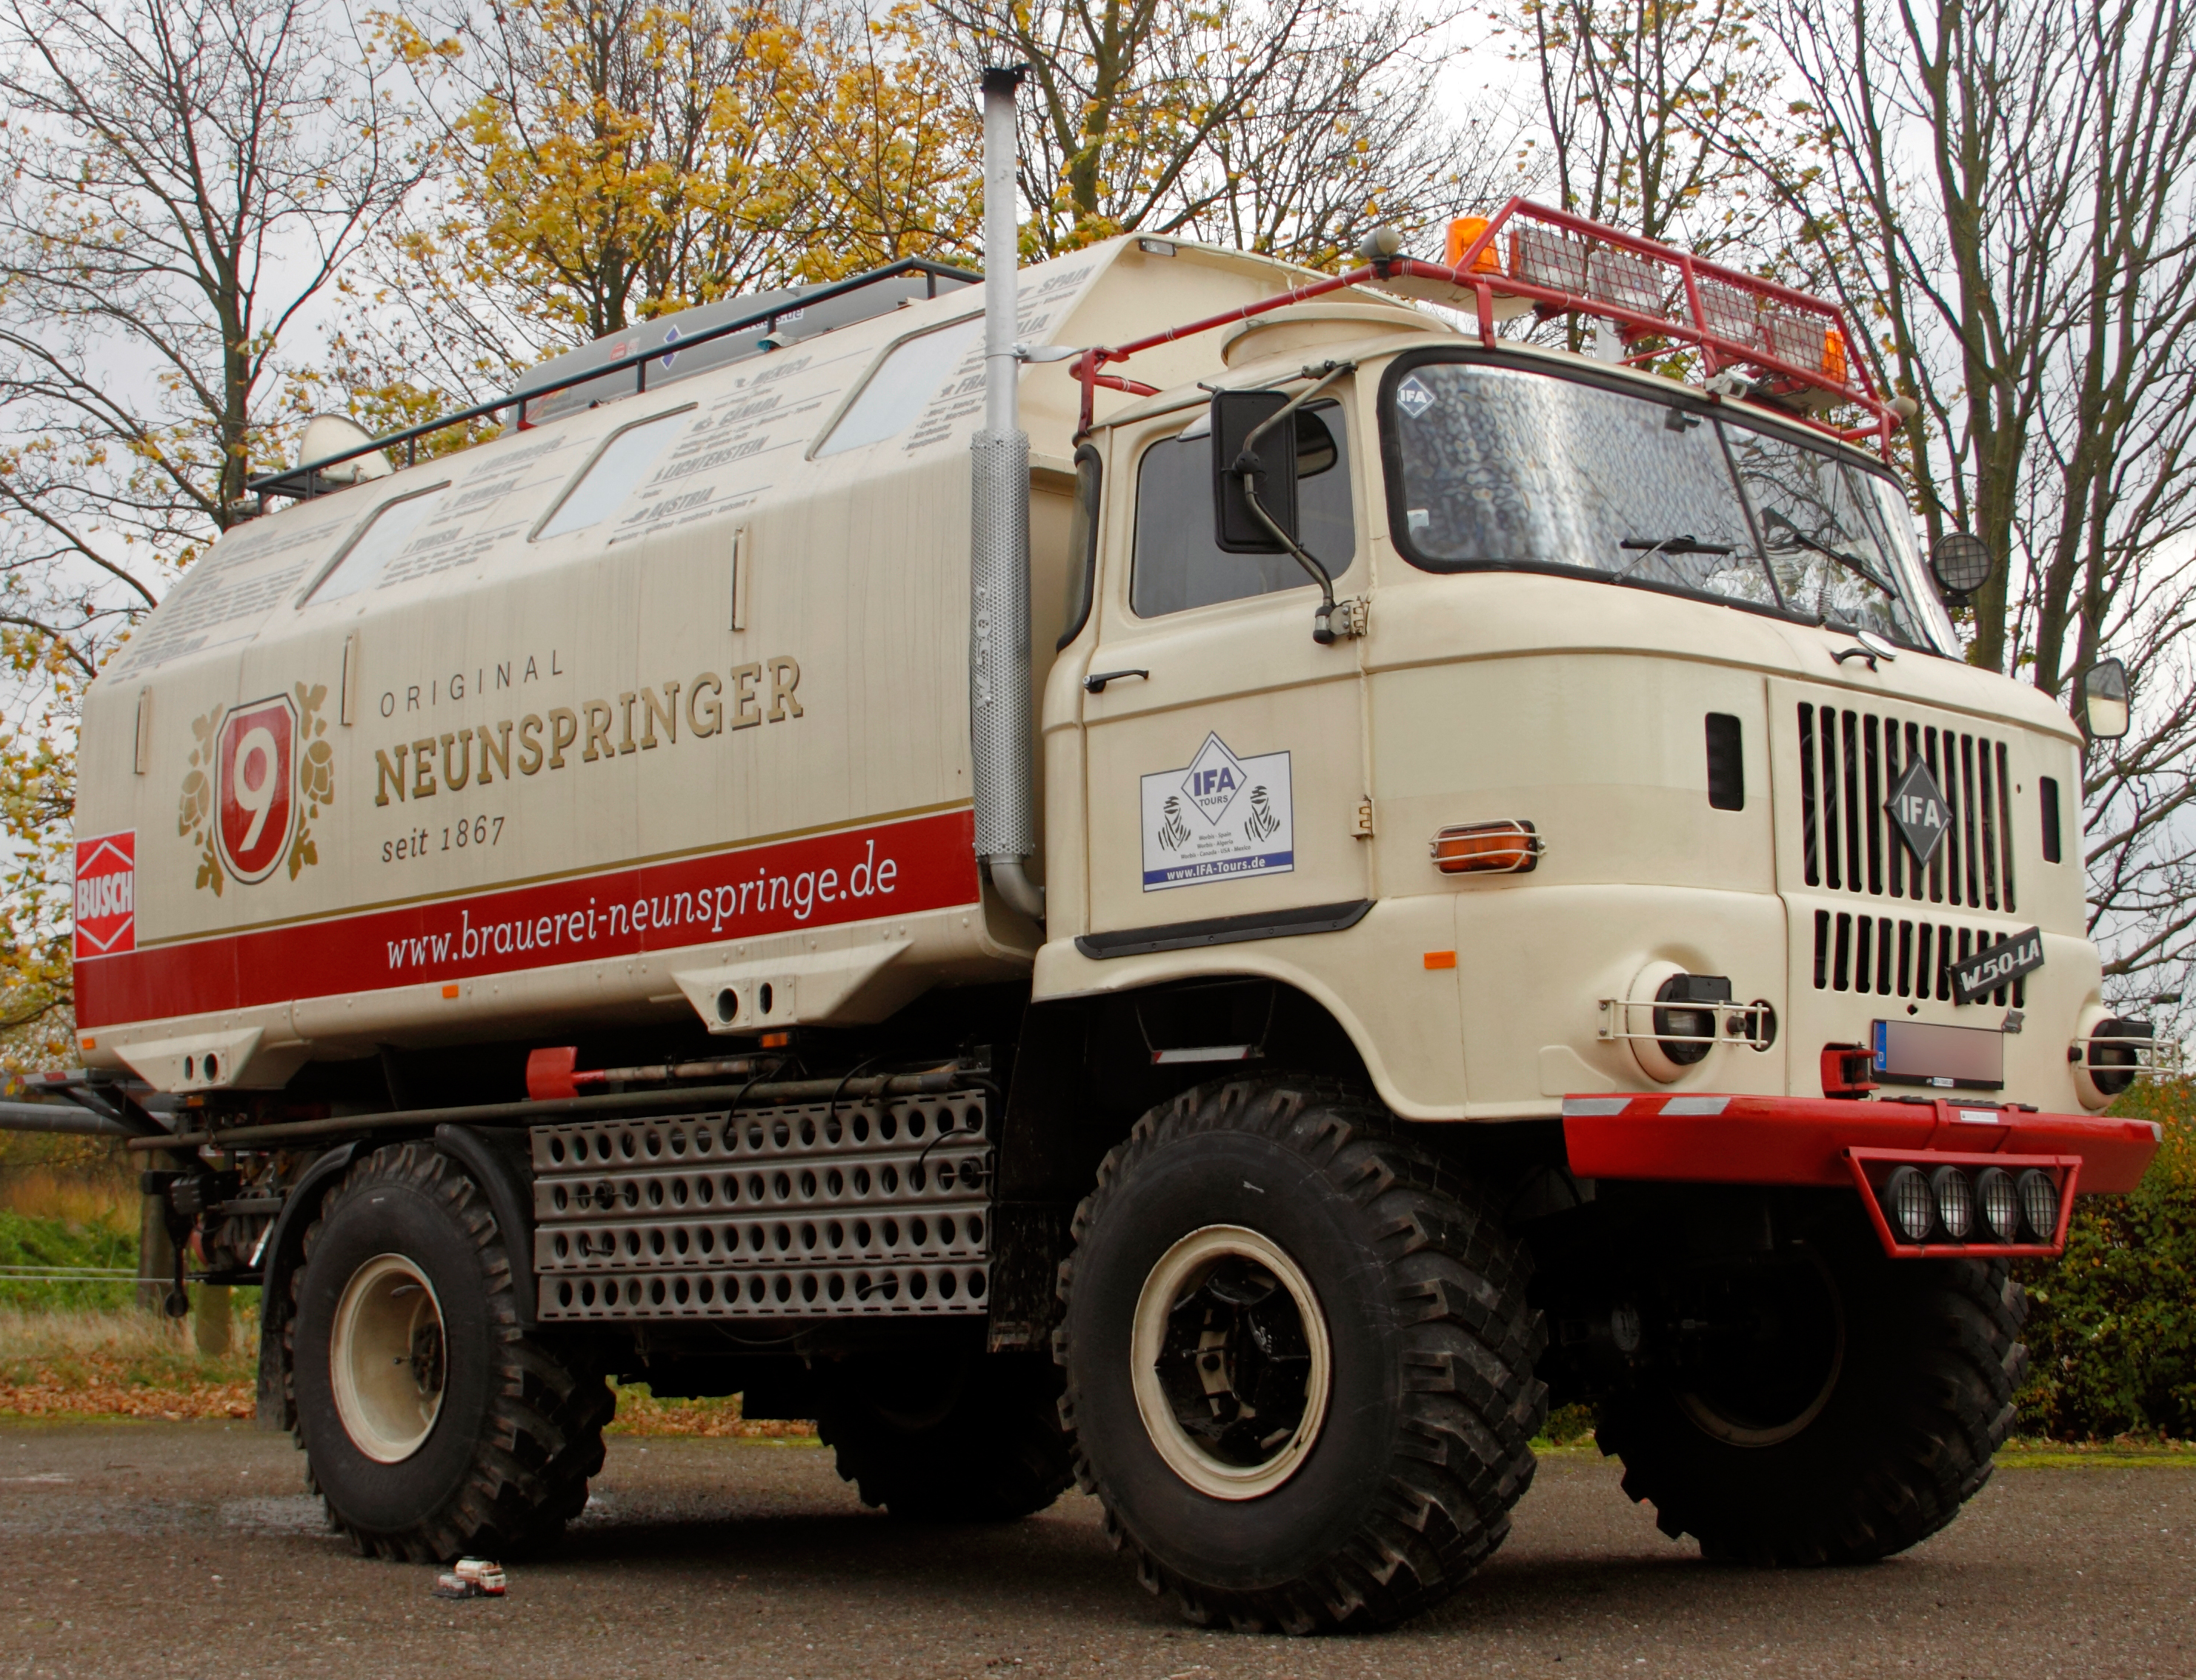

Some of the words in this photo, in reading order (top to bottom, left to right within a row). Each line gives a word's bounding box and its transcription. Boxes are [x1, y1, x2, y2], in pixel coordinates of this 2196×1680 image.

[1038, 264, 1096, 294] SPAIN
[750, 355, 813, 387] MEXICO
[954, 373, 987, 395] FRA
[718, 393, 783, 427] CANADA
[1400, 388, 1427, 404] IFA
[662, 435, 771, 481] LICHTENSTEIN
[646, 486, 716, 520] AUSTRIA
[381, 650, 564, 718] ORIGINAL
[374, 655, 804, 807] NEUNSPRINGER
[232, 725, 278, 852] 9
[1193, 767, 1237, 797] IFA
[1200, 795, 1228, 807] TOURS
[1901, 794, 1941, 830] IFA
[382, 824, 429, 864] seit
[440, 815, 506, 850] 1867
[1217, 839, 1234, 847] Algeria
[1167, 856, 1265, 881] www.IFA-Tours.de
[76, 870, 134, 921] BUSCH
[386, 839, 899, 970] www.brauerei-neunspringe.de
